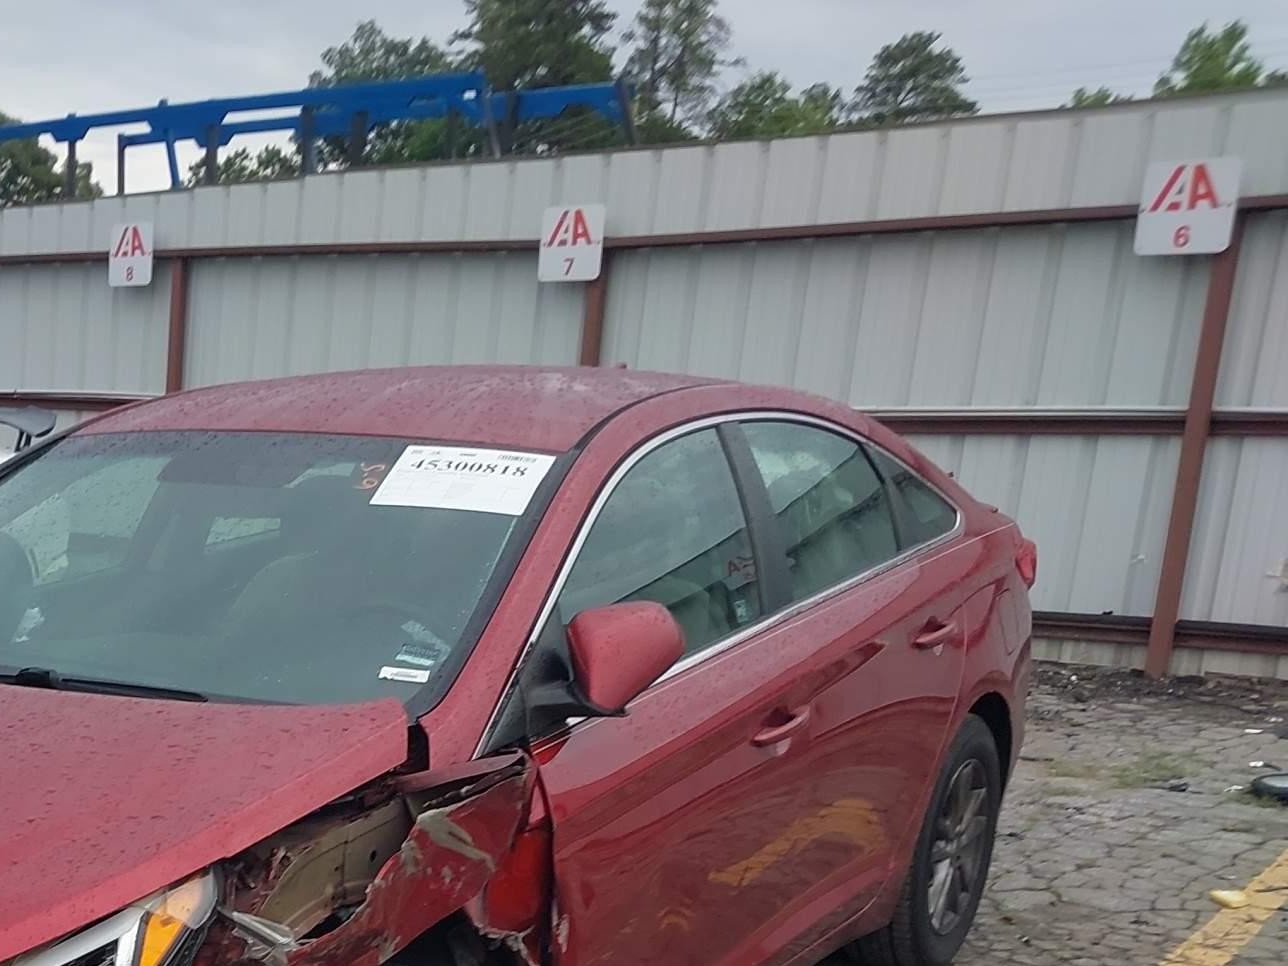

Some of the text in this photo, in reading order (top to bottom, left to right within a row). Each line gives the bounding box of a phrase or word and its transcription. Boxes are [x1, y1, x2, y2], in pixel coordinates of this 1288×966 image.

[1173, 225, 1191, 248] 6
[125, 266, 134, 282] 8
[563, 257, 576, 276] 7
[410, 458, 529, 477] 45300818
